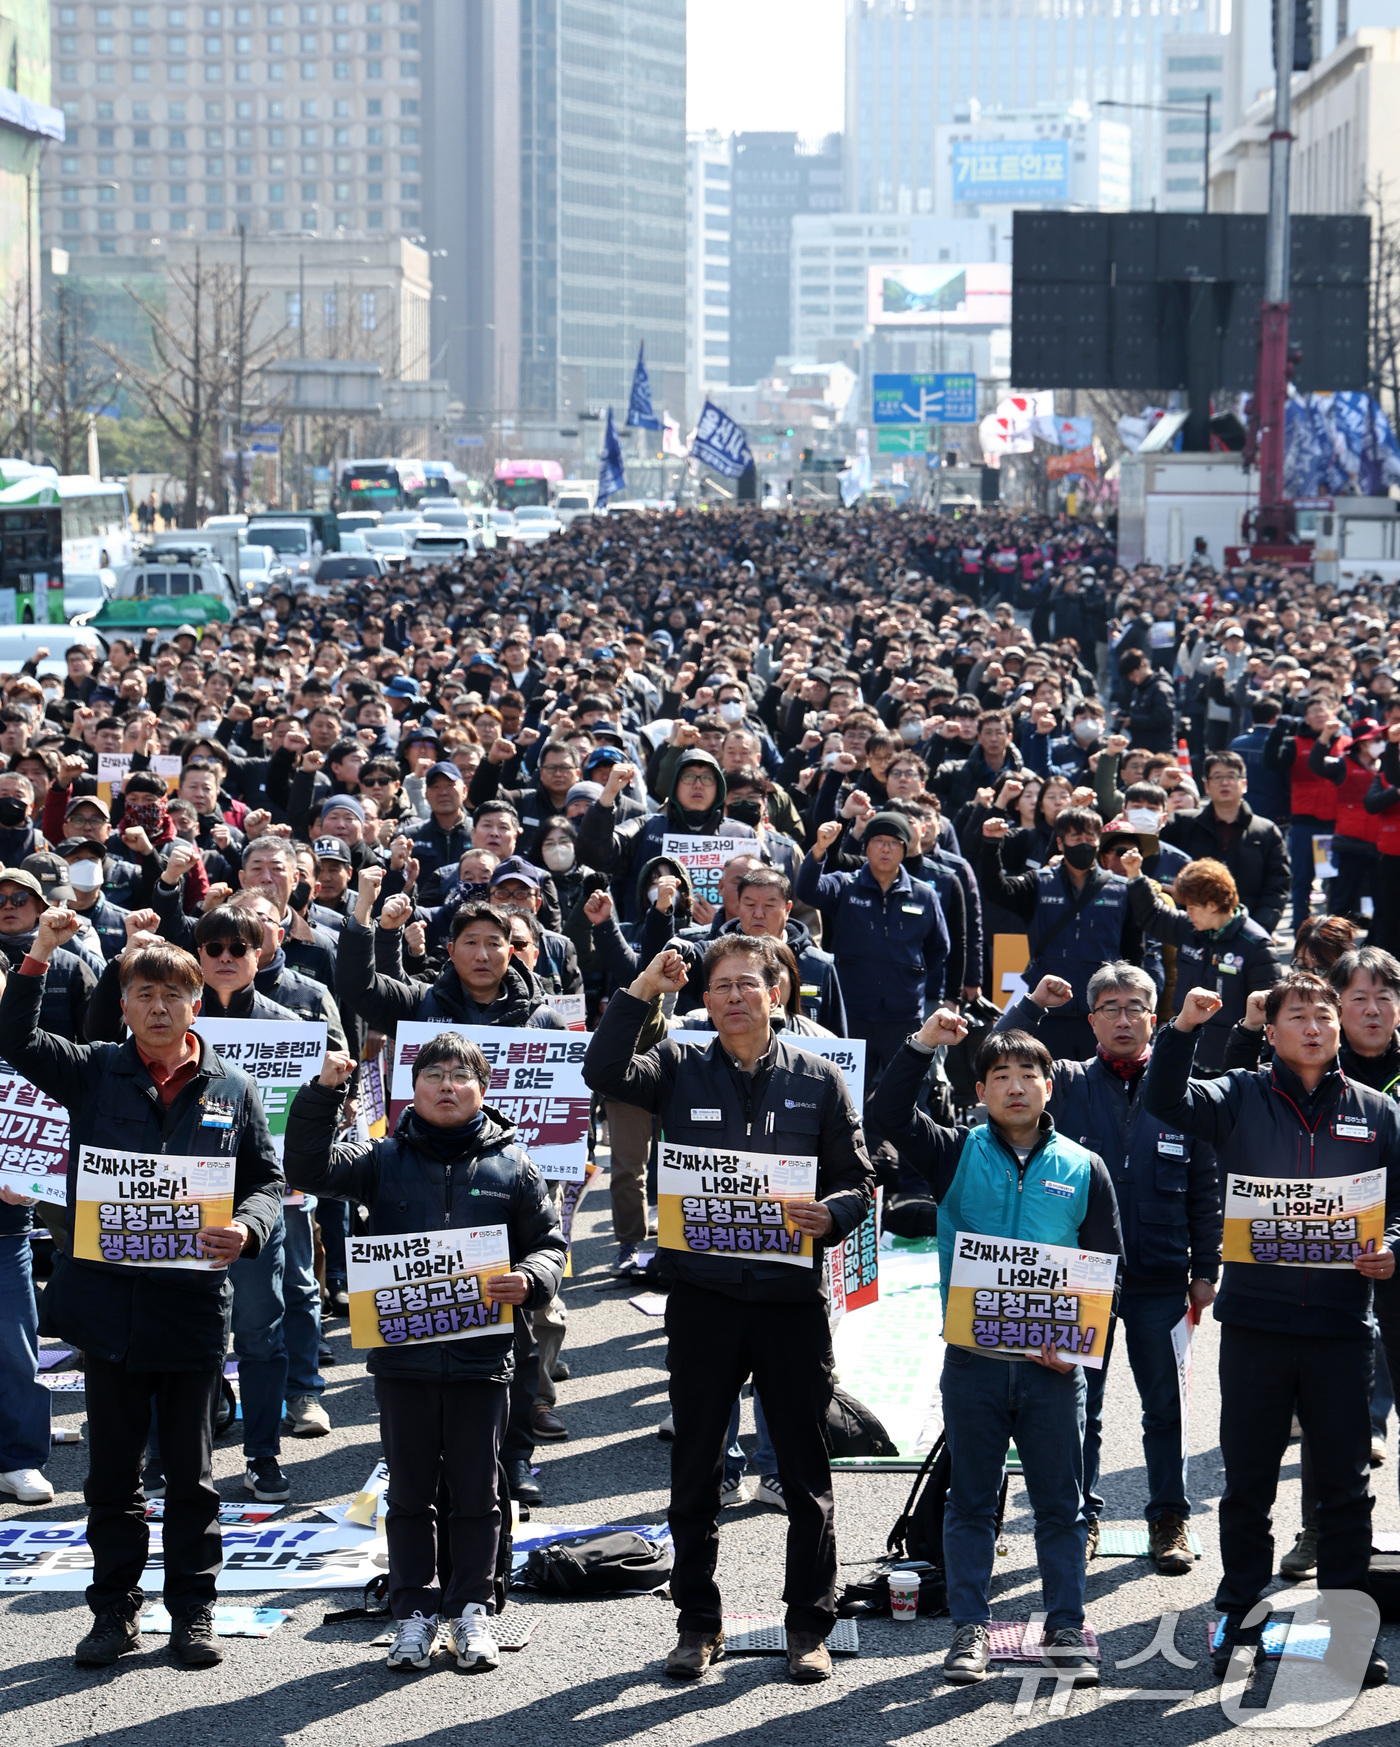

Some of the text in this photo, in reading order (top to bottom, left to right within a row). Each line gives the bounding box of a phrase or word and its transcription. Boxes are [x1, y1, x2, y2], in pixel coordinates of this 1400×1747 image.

[957, 154, 1064, 182] 기프트인포
[666, 840, 734, 853] 모든 노동자의
[244, 1041, 321, 1059] 기능훈련과
[514, 1068, 553, 1089] 없는
[83, 1152, 157, 1178] 진짜사장
[663, 1148, 740, 1174] 진짜사장
[119, 1177, 189, 1200] 나와라!
[701, 1174, 770, 1196] 나와라!
[1232, 1179, 1313, 1199] 진짜사장
[99, 1203, 201, 1232] 원청교섭
[682, 1197, 784, 1225] 원청교섭
[1273, 1195, 1344, 1216] 나와라!
[683, 1225, 802, 1253] 쟁취하자!
[1250, 1217, 1358, 1241] 원청교섭
[351, 1237, 431, 1263] 진짜사장
[844, 1226, 861, 1295] 투쟁으
[959, 1238, 1040, 1266] 진짜사장
[393, 1250, 465, 1282] 나와라!
[997, 1267, 1068, 1289] 나와라!
[375, 1275, 481, 1316] 원청교섭
[974, 1290, 1079, 1322] 원청교섭
[379, 1301, 500, 1344] 쟁취하자!
[972, 1319, 1096, 1353] 쟁취하자!
